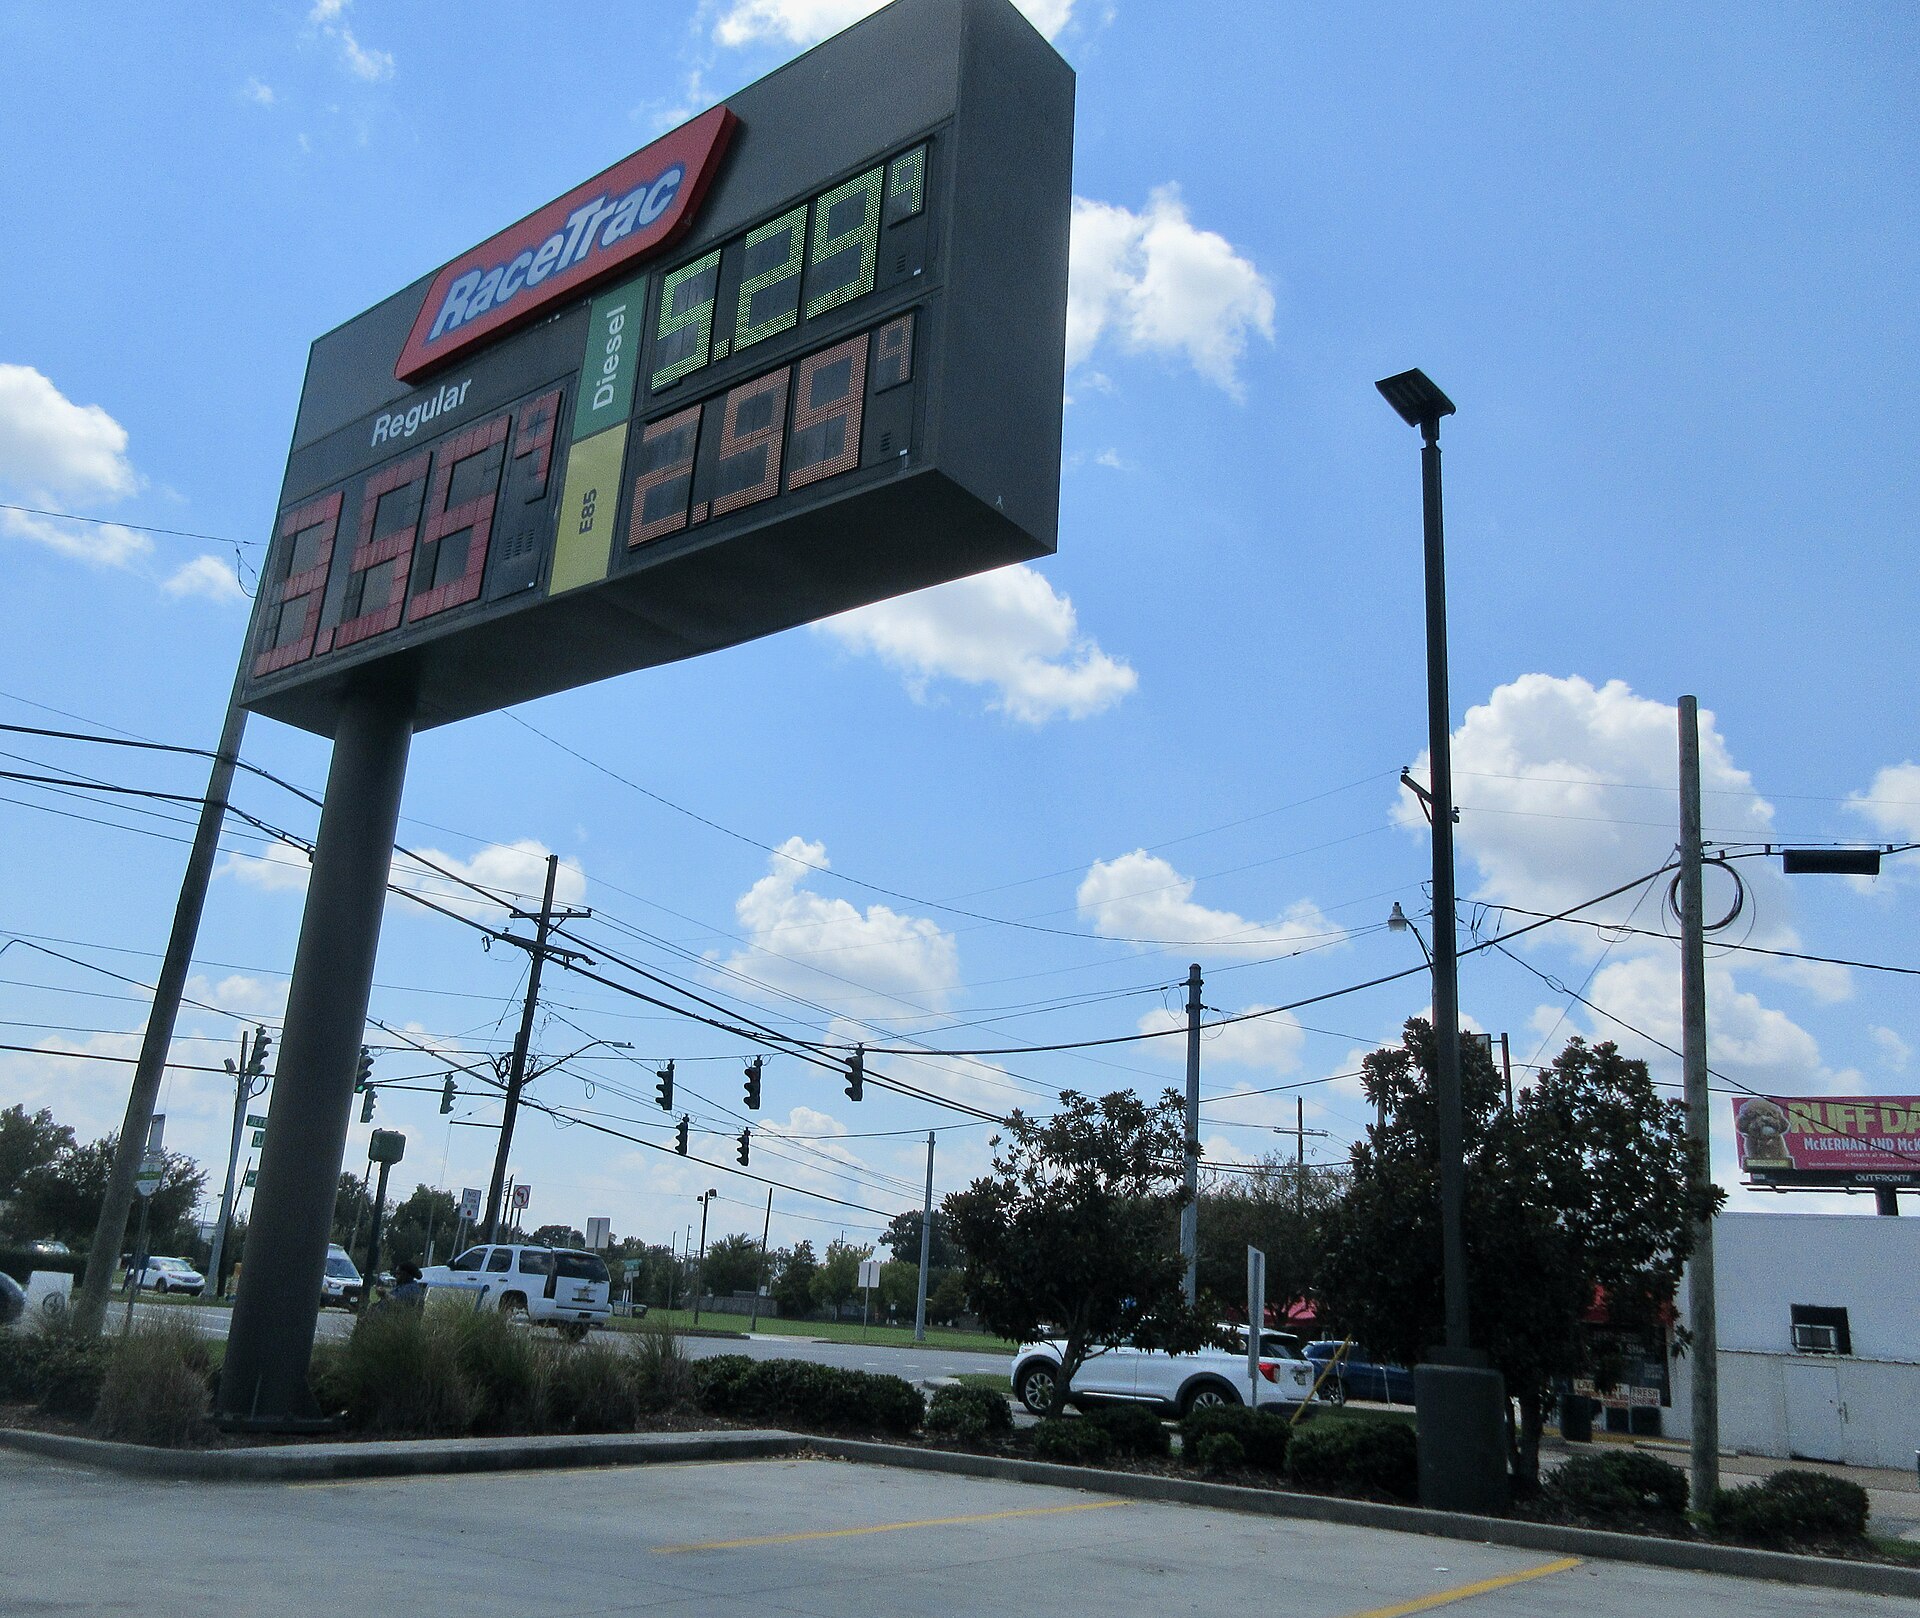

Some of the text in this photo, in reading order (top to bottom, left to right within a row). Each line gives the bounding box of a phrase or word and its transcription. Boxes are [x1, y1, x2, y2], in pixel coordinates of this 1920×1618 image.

[427, 168, 682, 342] RaceTrac
[592, 303, 627, 411] Diesel
[370, 379, 472, 448] Regular
[579, 487, 598, 536] E85
[1787, 1101, 1876, 1134] RUFF
[1803, 1137, 1867, 1151] McKERNAN
[1870, 1137, 1895, 1152] AND
[1631, 1386, 1659, 1399] FRESH
